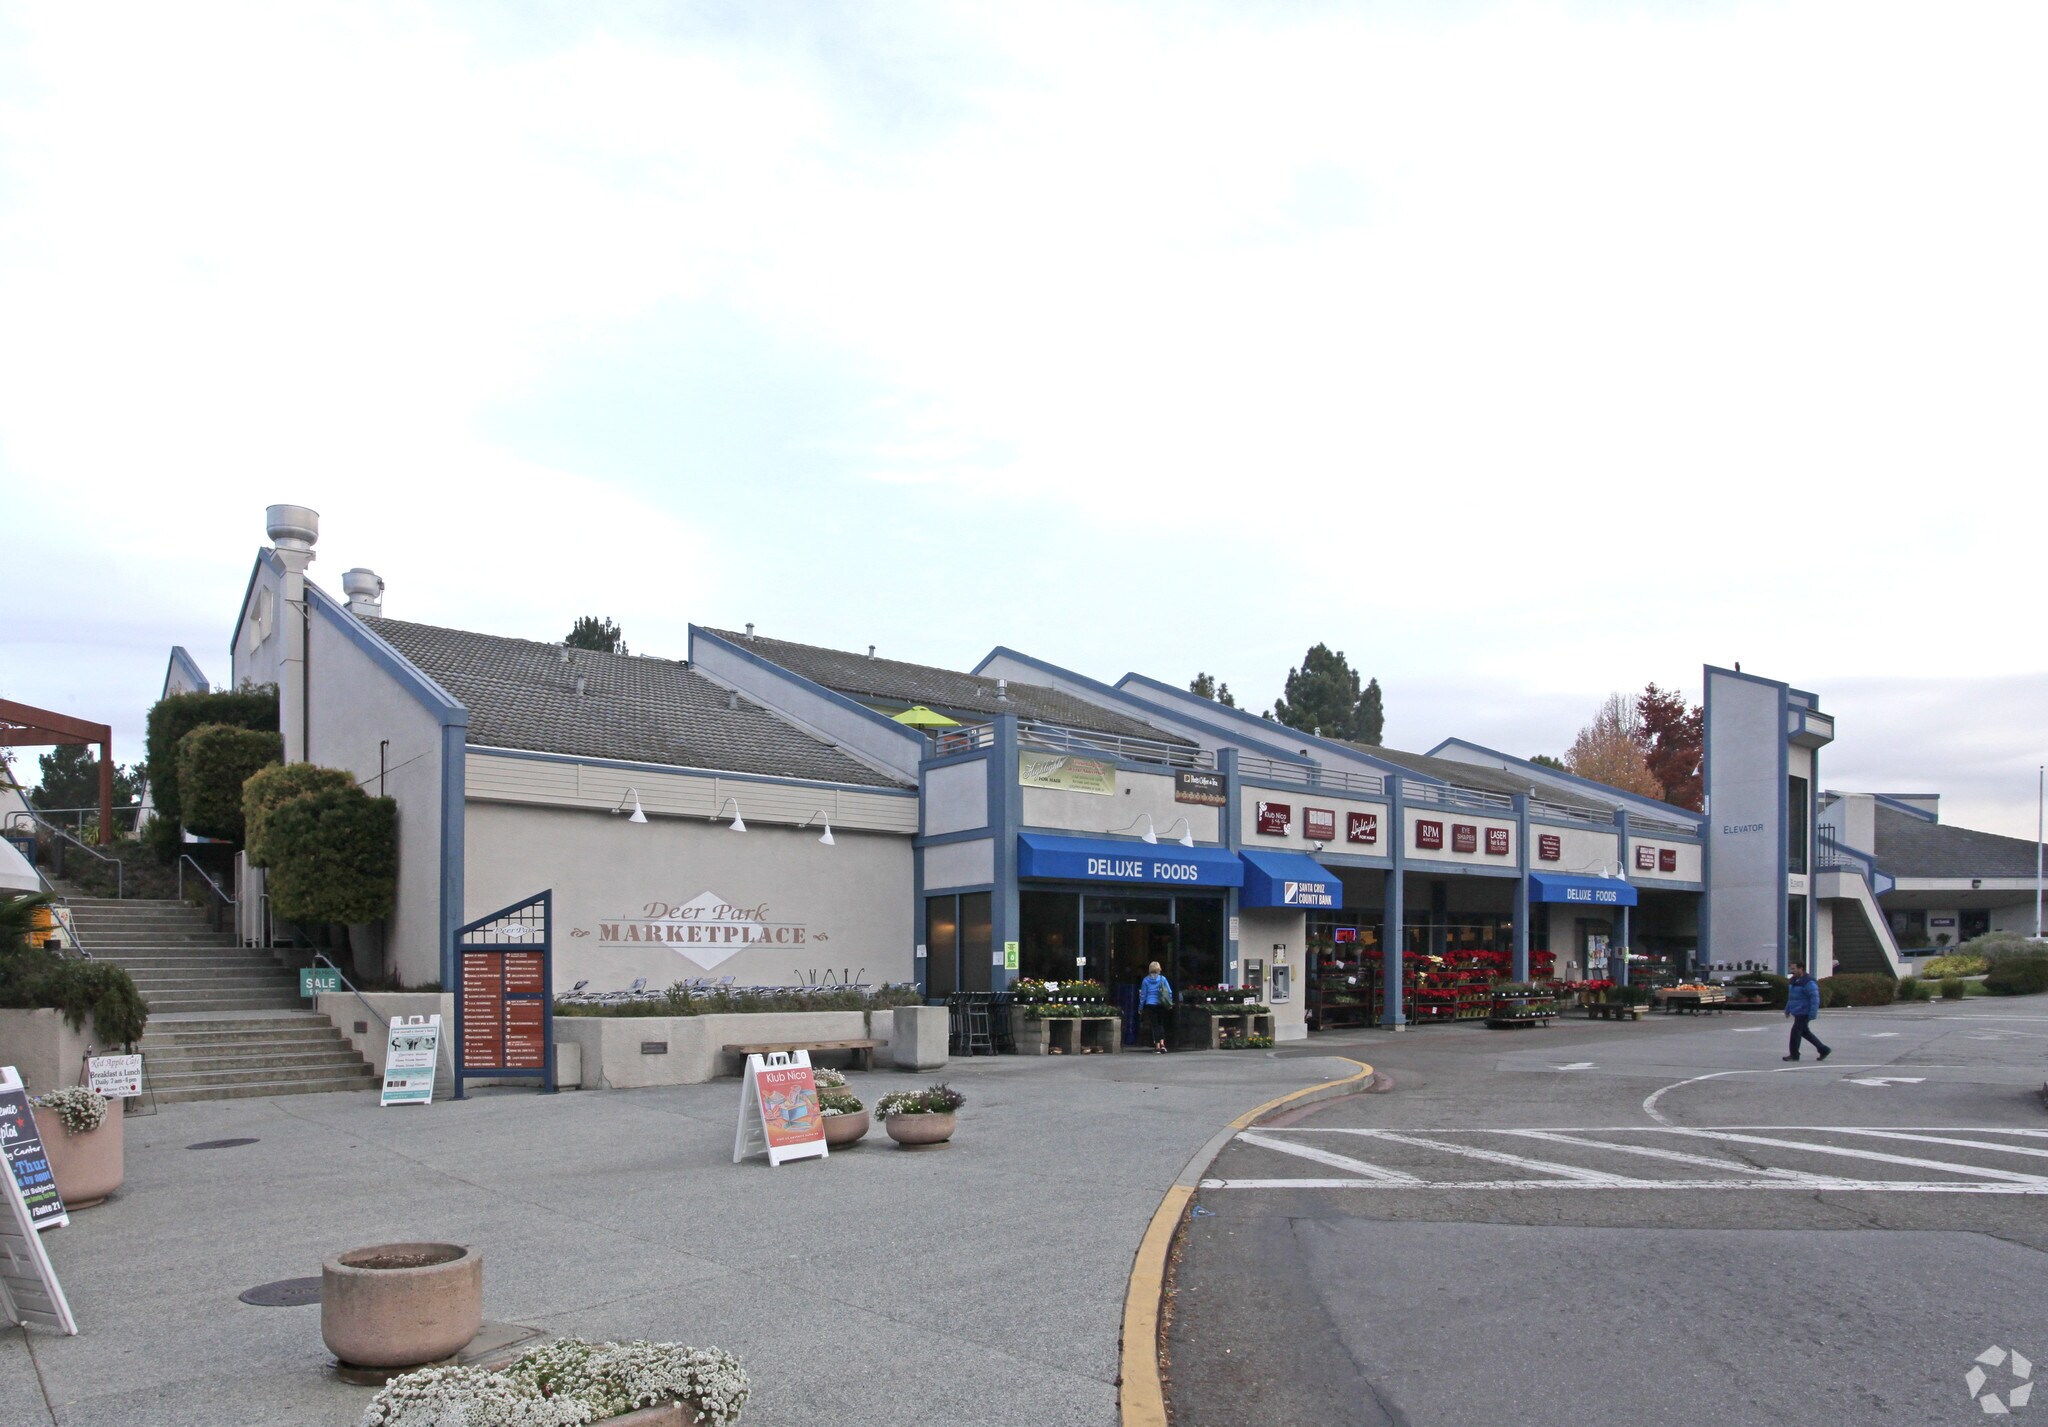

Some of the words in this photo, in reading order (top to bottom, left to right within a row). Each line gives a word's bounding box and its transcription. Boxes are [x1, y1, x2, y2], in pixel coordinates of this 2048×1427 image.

[1264, 811, 1275, 819] Klub
[1275, 812, 1287, 820] Nico
[1423, 825, 1439, 838] RPM
[1723, 823, 1764, 834] ELEVATOR
[1457, 833, 1475, 841] SHAPES
[1490, 830, 1507, 840] LASER
[1088, 858, 1143, 878] DELUXE
[1154, 863, 1198, 881] FOODS
[1299, 882, 1313, 893] SANTA
[1314, 883, 1325, 893] CRUZ
[1299, 893, 1318, 904] COUNTY
[1319, 894, 1332, 906] BANK
[1567, 888, 1592, 901] DELUXE
[1596, 890, 1617, 902] FOODS
[643, 901, 706, 920] Deer
[712, 902, 770, 922] Park
[598, 923, 806, 945] MARKETPLACE
[306, 978, 336, 989] SALE
[90, 1069, 118, 1079] Breakfast
[124, 1068, 141, 1076] Lunch
[766, 1072, 786, 1083] Klub
[786, 1070, 807, 1081] Nico
[95, 1078, 109, 1086] Daily
[13, 1145, 41, 1156] Center
[30, 1183, 56, 1195] Subjects
[52, 1201, 61, 1211] 21
